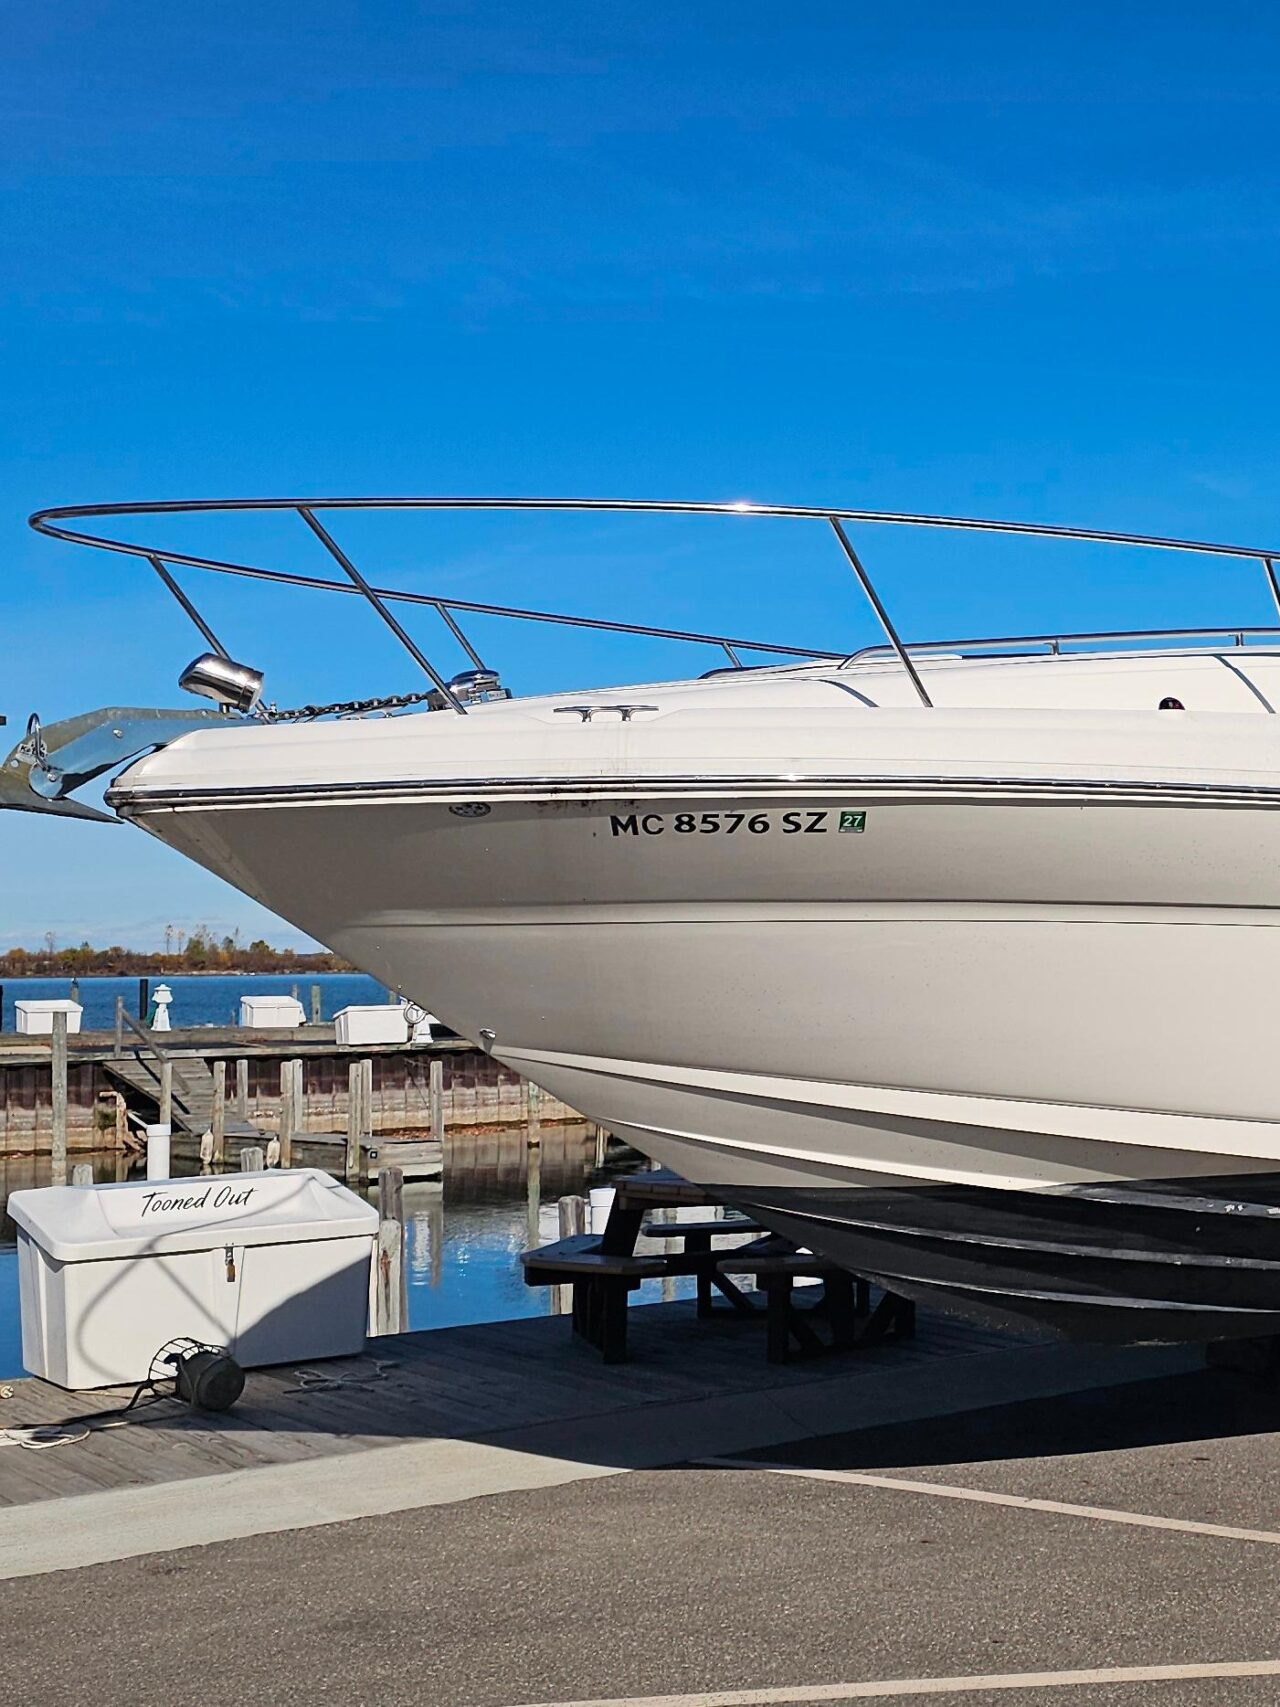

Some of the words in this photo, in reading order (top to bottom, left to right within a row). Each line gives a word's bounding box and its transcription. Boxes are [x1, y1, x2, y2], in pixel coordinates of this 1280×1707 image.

[609, 814, 665, 837] MC
[673, 812, 770, 835] 8576
[782, 811, 828, 833] SZ
[843, 815, 863, 827] 27
[141, 1186, 213, 1218] Tooned
[213, 1185, 259, 1209] Out
